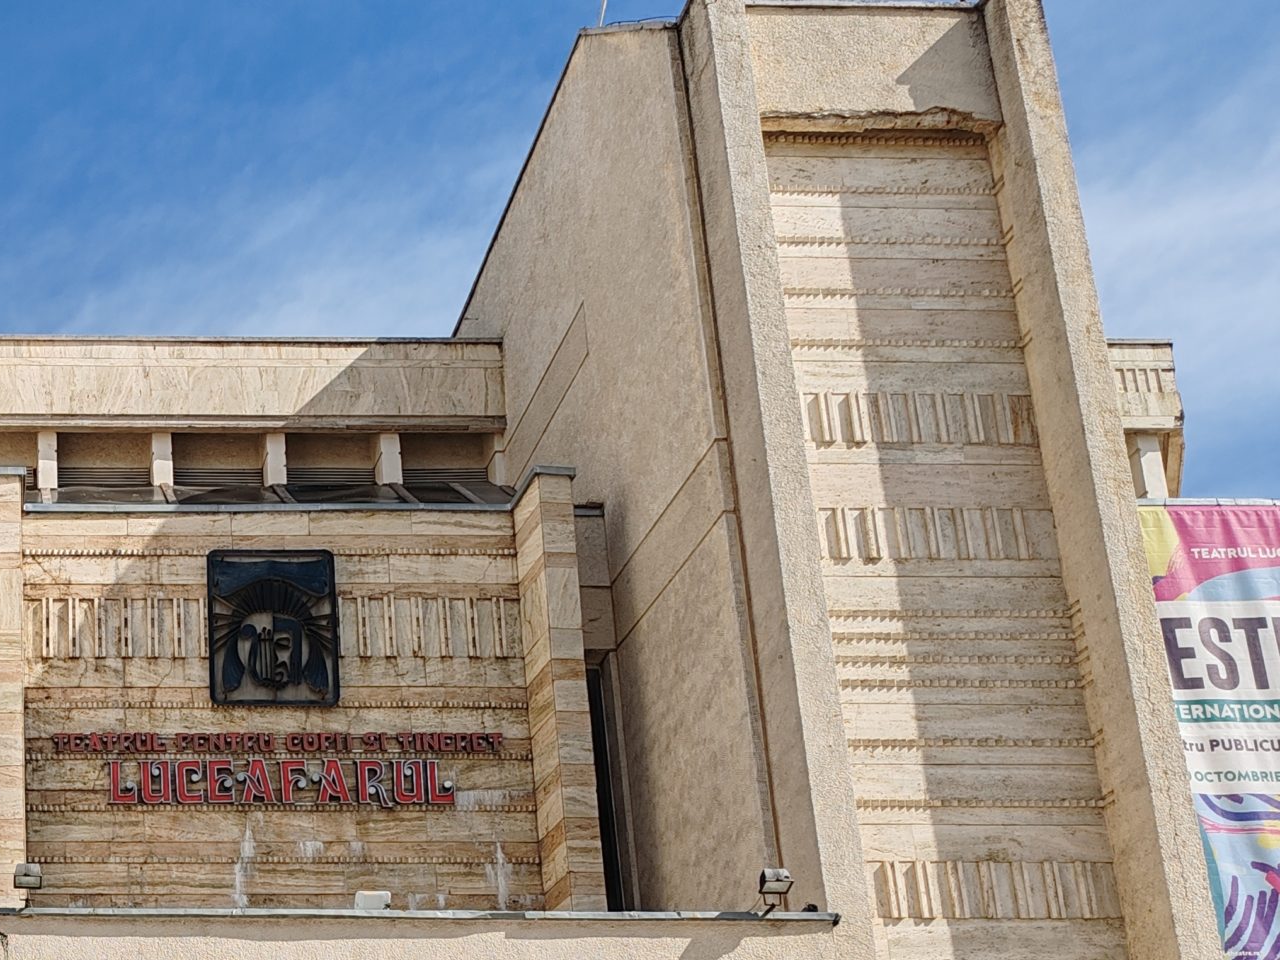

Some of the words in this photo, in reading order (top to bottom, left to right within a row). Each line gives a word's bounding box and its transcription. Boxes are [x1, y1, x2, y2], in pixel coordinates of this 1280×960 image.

[1191, 547, 1256, 559] TEATRUL
[54, 732, 167, 752] TEATRUL
[175, 732, 275, 752] PENTRU
[286, 732, 352, 751] COPII
[397, 732, 503, 752] TINERET
[107, 757, 456, 807] LUCEAFARUL
[1194, 770, 1280, 783] OCTOMBRIE
